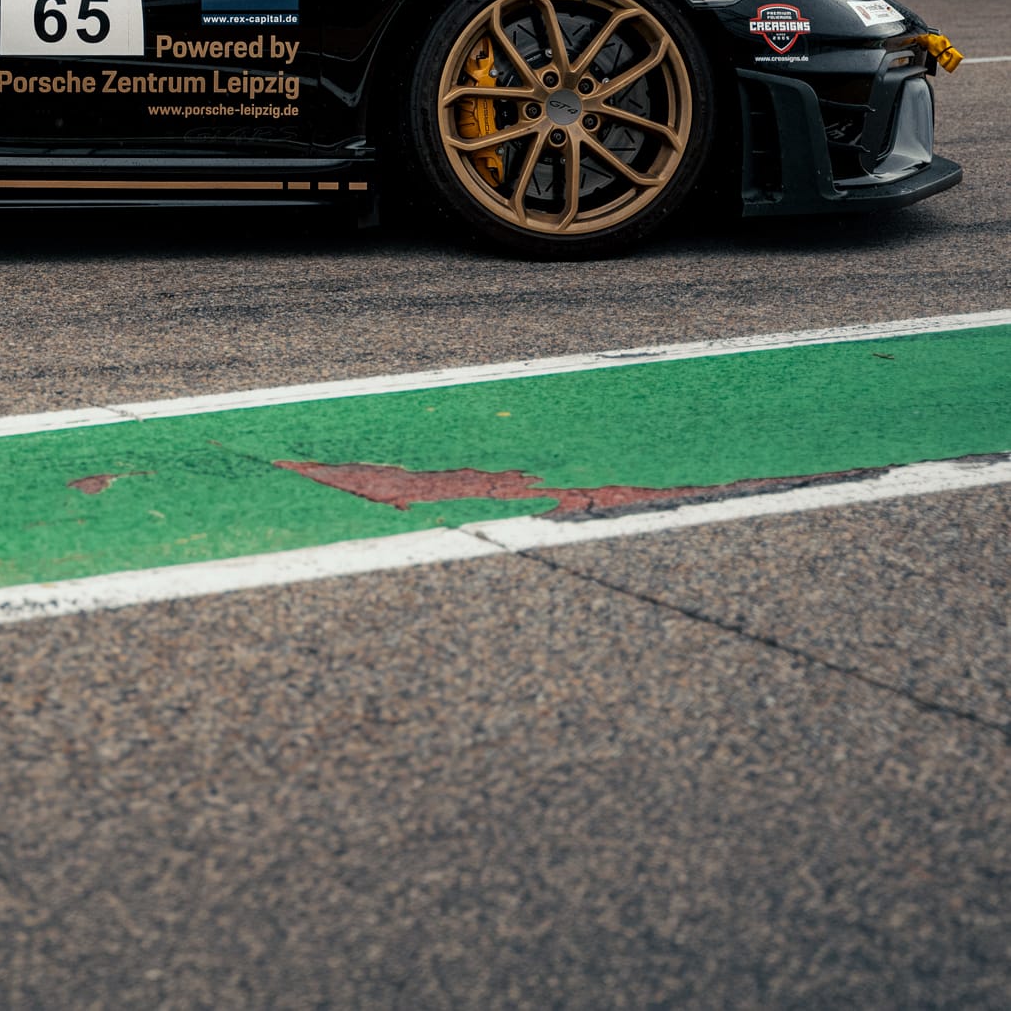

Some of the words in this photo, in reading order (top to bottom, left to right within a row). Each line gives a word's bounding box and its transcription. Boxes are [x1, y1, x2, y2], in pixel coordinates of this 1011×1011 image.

[203, 14, 298, 25] www.rex-capital.de
[750, 21, 811, 31] CREASIGNS
[156, 34, 263, 59] Powered
[271, 34, 300, 64] by
[754, 55, 809, 63] www.creasigns.de
[101, 70, 206, 93] Zentrum
[213, 70, 300, 99] Leipzig
[148, 104, 299, 119] www.porsche-leipzig.de
